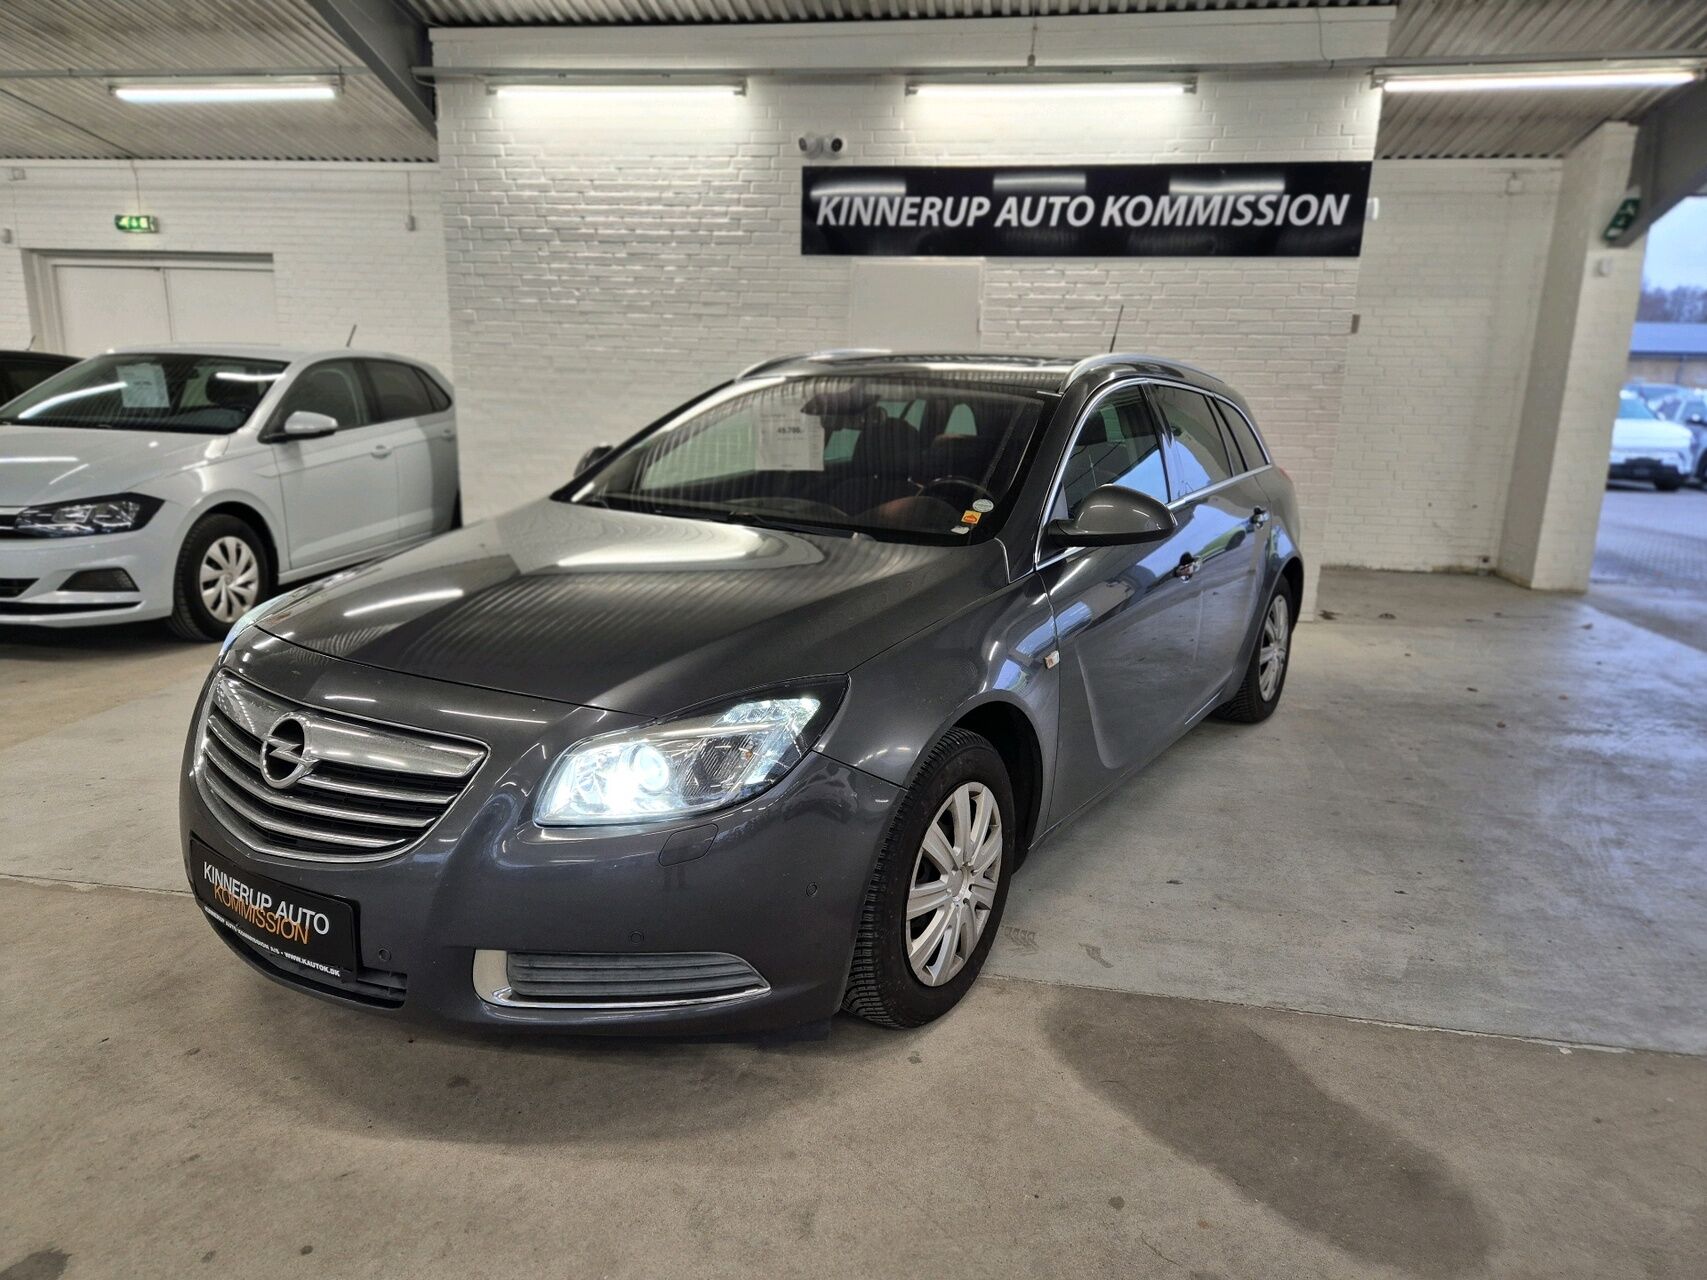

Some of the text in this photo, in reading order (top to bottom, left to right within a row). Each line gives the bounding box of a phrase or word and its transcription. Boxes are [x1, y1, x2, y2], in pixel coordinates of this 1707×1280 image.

[816, 194, 1350, 228] KINNERUP AUTO KOMMISSION
[204, 862, 330, 934] KINNERUP AUTO
[214, 885, 309, 945] KOMMISSION
